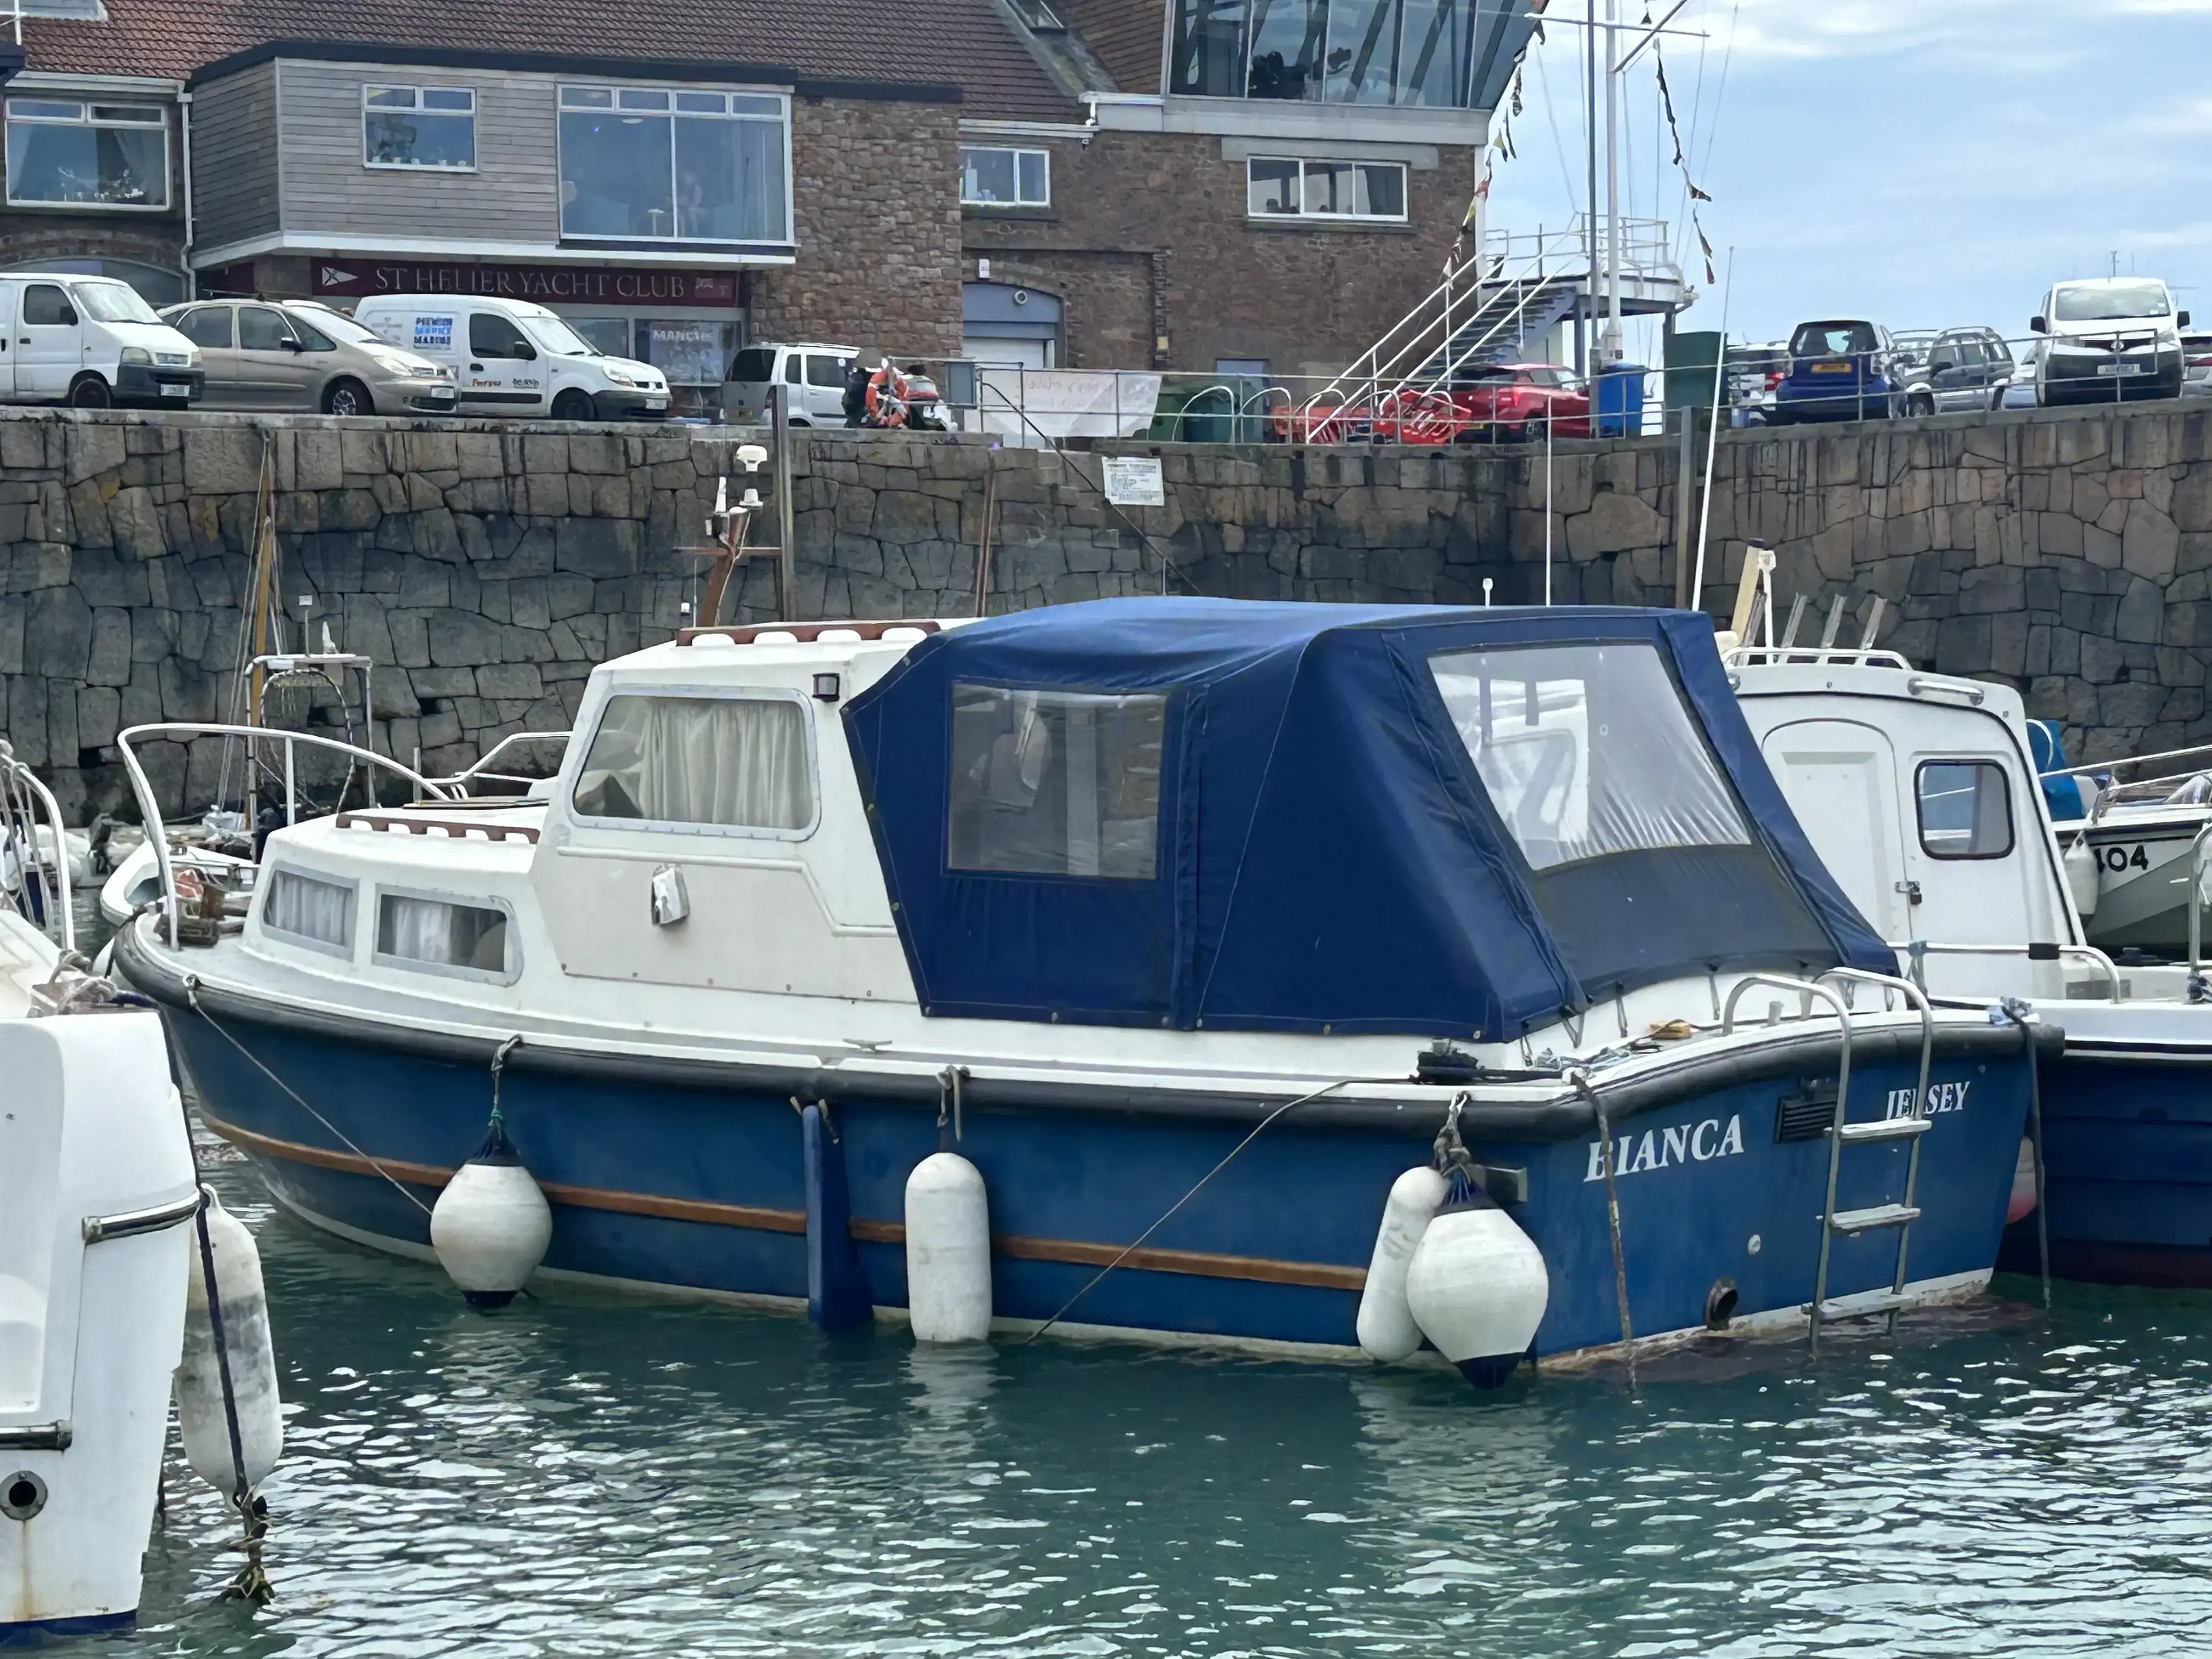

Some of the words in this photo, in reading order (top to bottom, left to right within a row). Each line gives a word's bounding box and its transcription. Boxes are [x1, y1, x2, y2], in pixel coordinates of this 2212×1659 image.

[375, 267, 408, 290] ST
[416, 268, 515, 295] HELIER
[518, 272, 610, 296] YACHT
[617, 275, 684, 298] CLUB
[1886, 1081, 1970, 1120] JESEY
[1583, 1114, 1744, 1183] BIANCA
